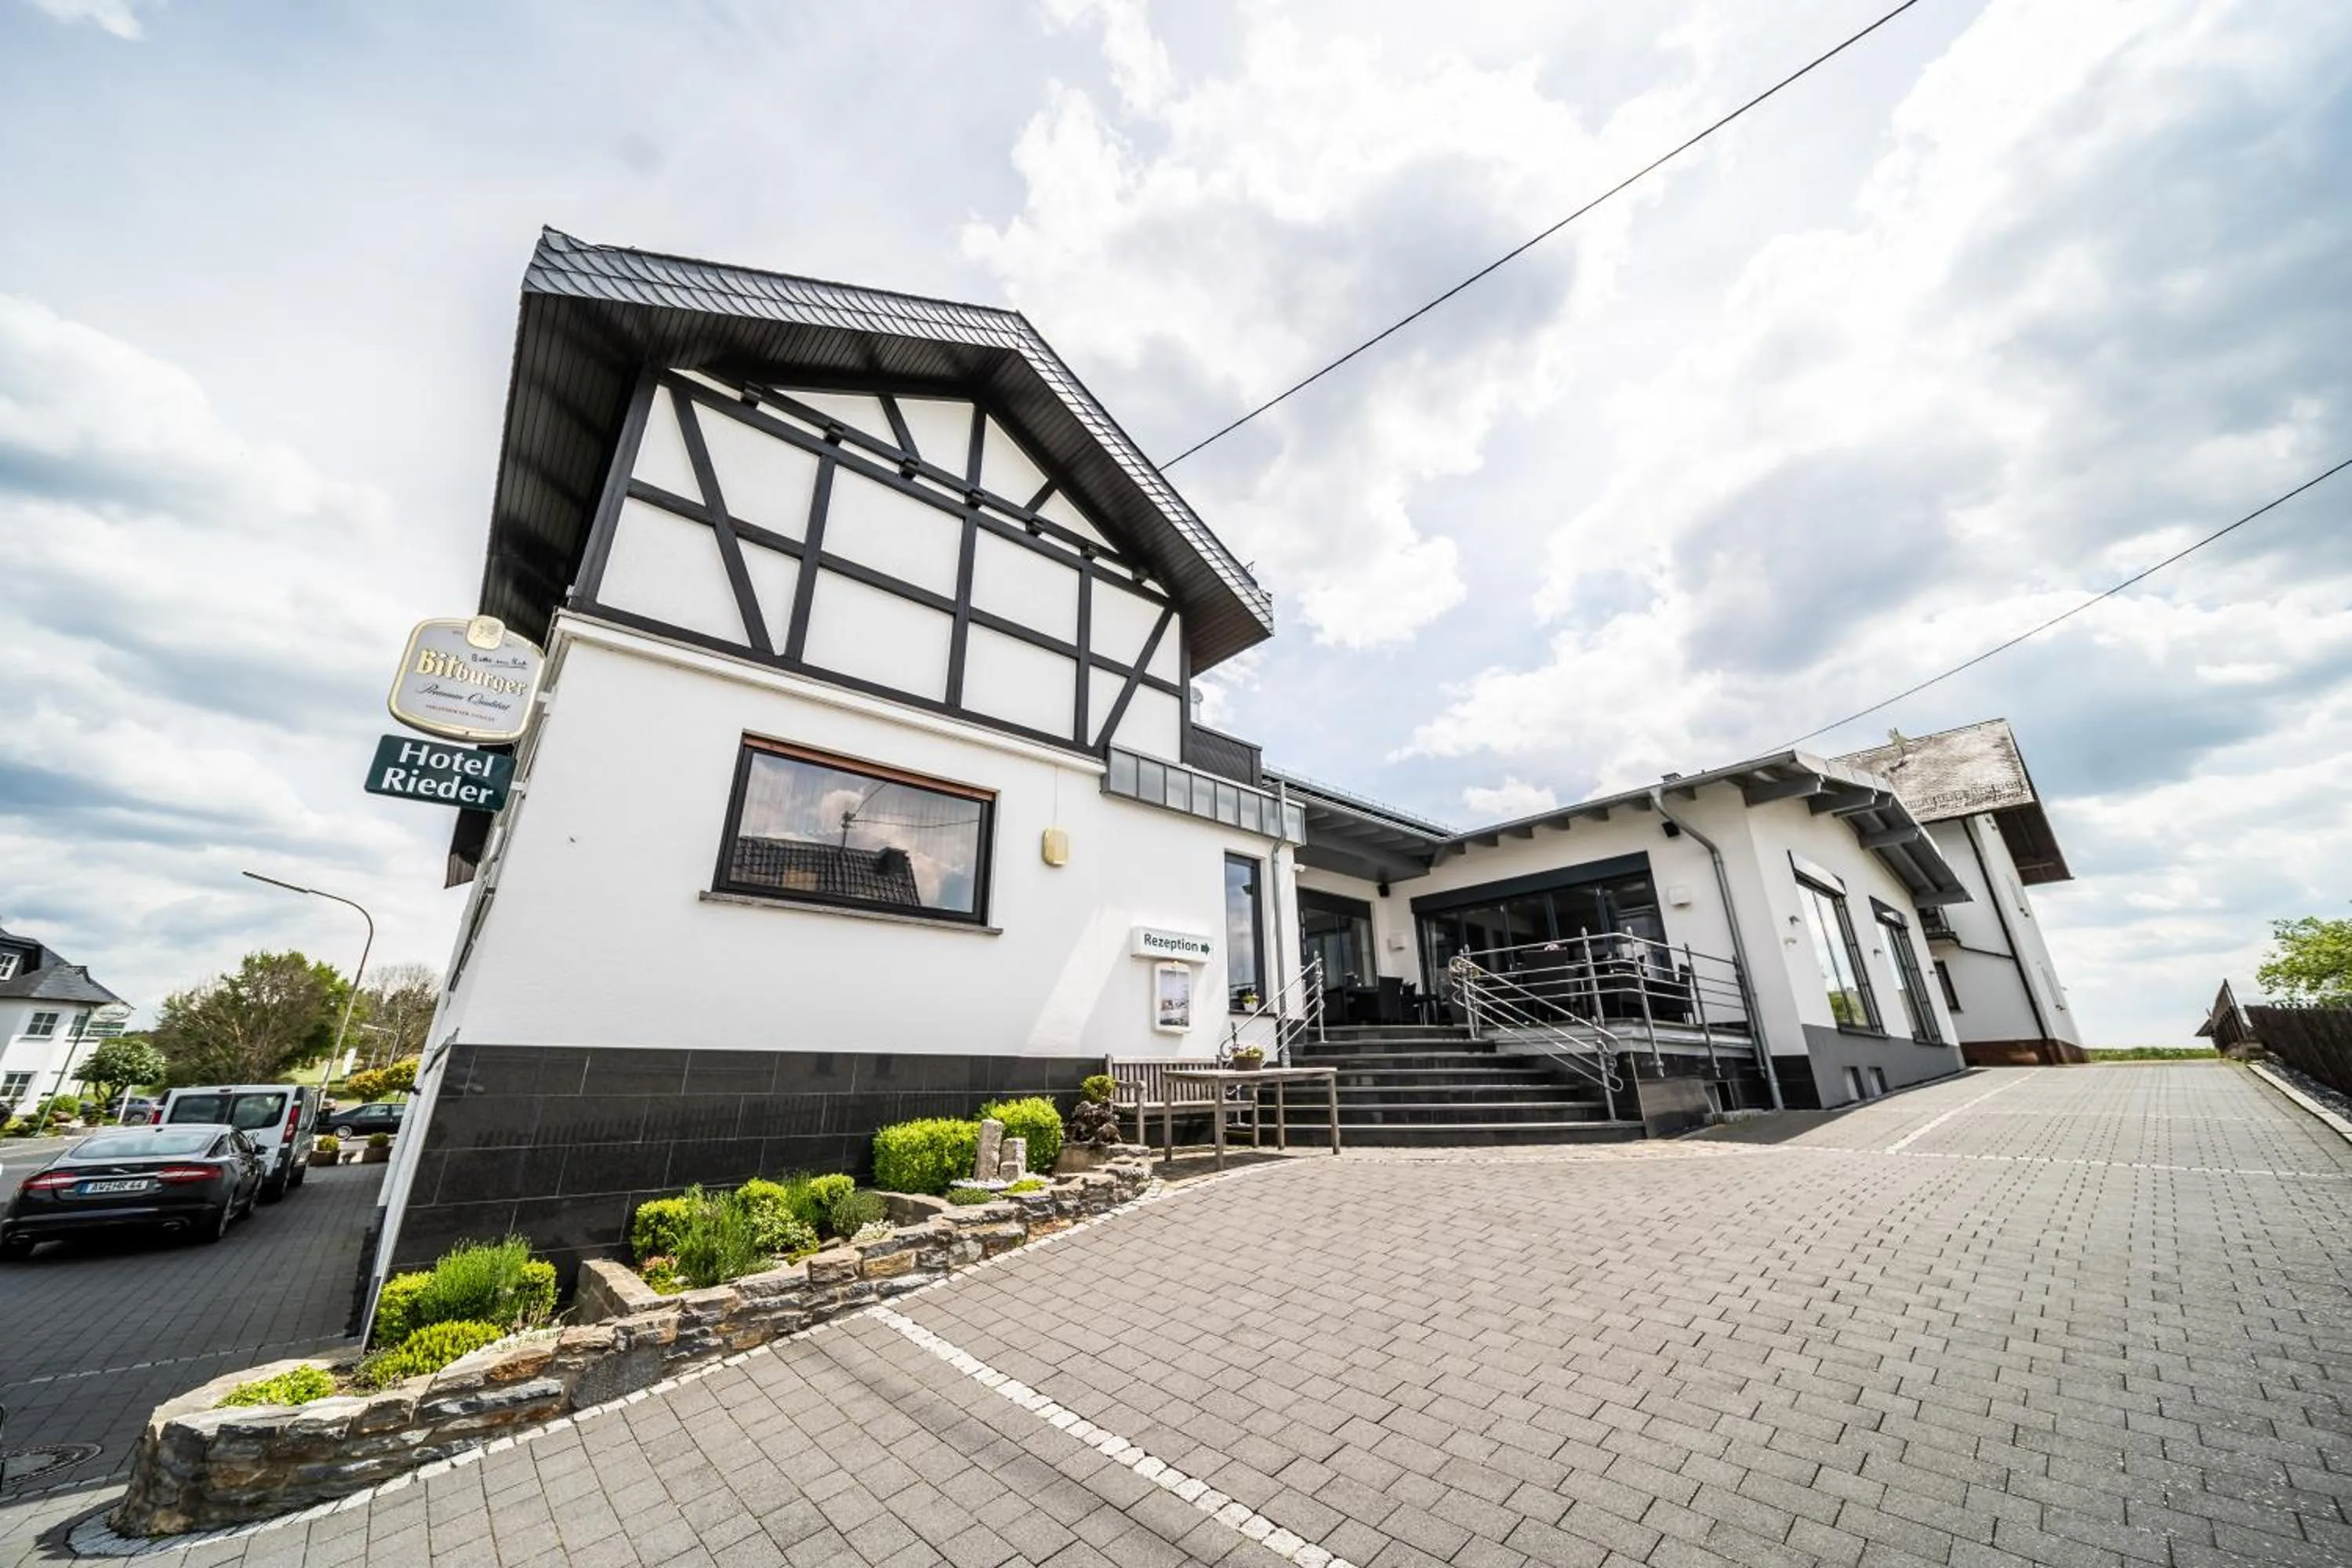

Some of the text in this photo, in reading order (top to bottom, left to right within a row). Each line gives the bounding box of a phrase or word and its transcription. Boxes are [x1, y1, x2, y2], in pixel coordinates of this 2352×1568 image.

[416, 649, 527, 695] Bitburger
[398, 742, 494, 778] Hotel
[382, 767, 493, 804] Rieder
[1144, 934, 1199, 952] Rezeption
